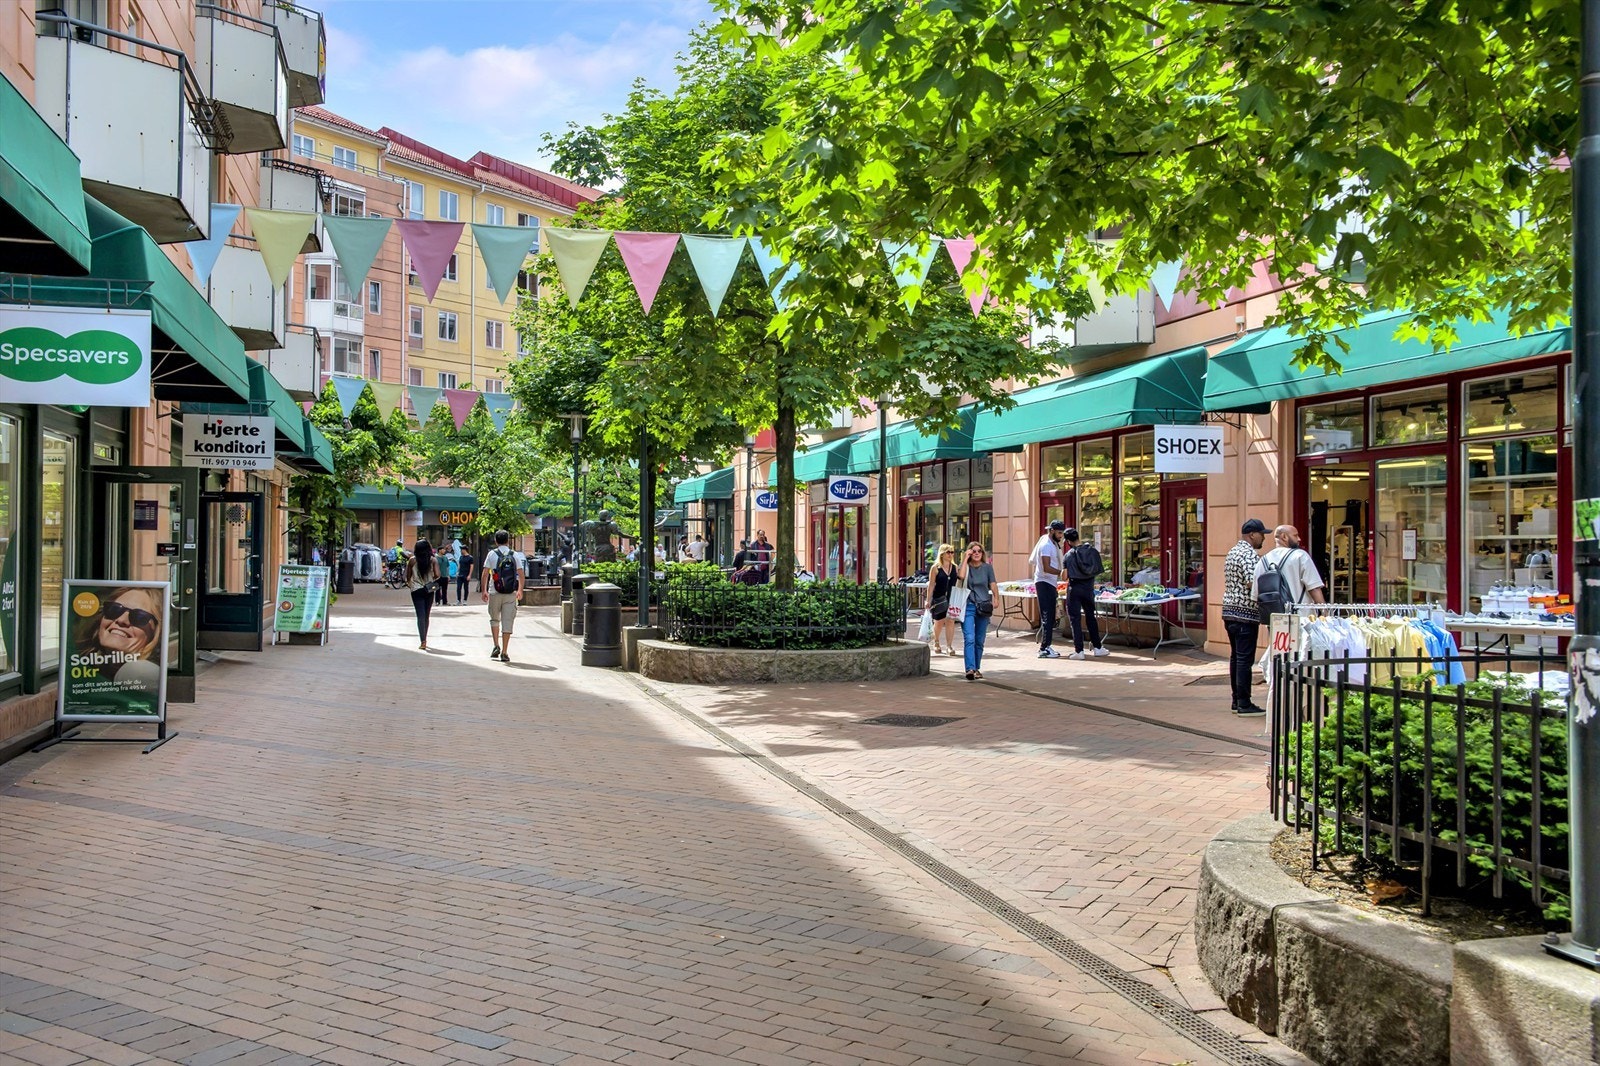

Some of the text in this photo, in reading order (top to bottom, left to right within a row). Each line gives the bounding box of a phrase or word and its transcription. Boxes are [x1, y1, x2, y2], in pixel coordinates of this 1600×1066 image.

[0, 342, 129, 365] Specsavers
[203, 419, 260, 439] Hjerte
[194, 439, 266, 454] konditori
[1157, 437, 1221, 455] SHOEX
[201, 458, 257, 467] Tlf. 967 10 946
[759, 492, 778, 508] SirPr
[70, 651, 140, 666] Solbriller
[71, 666, 100, 679] 0 kr
